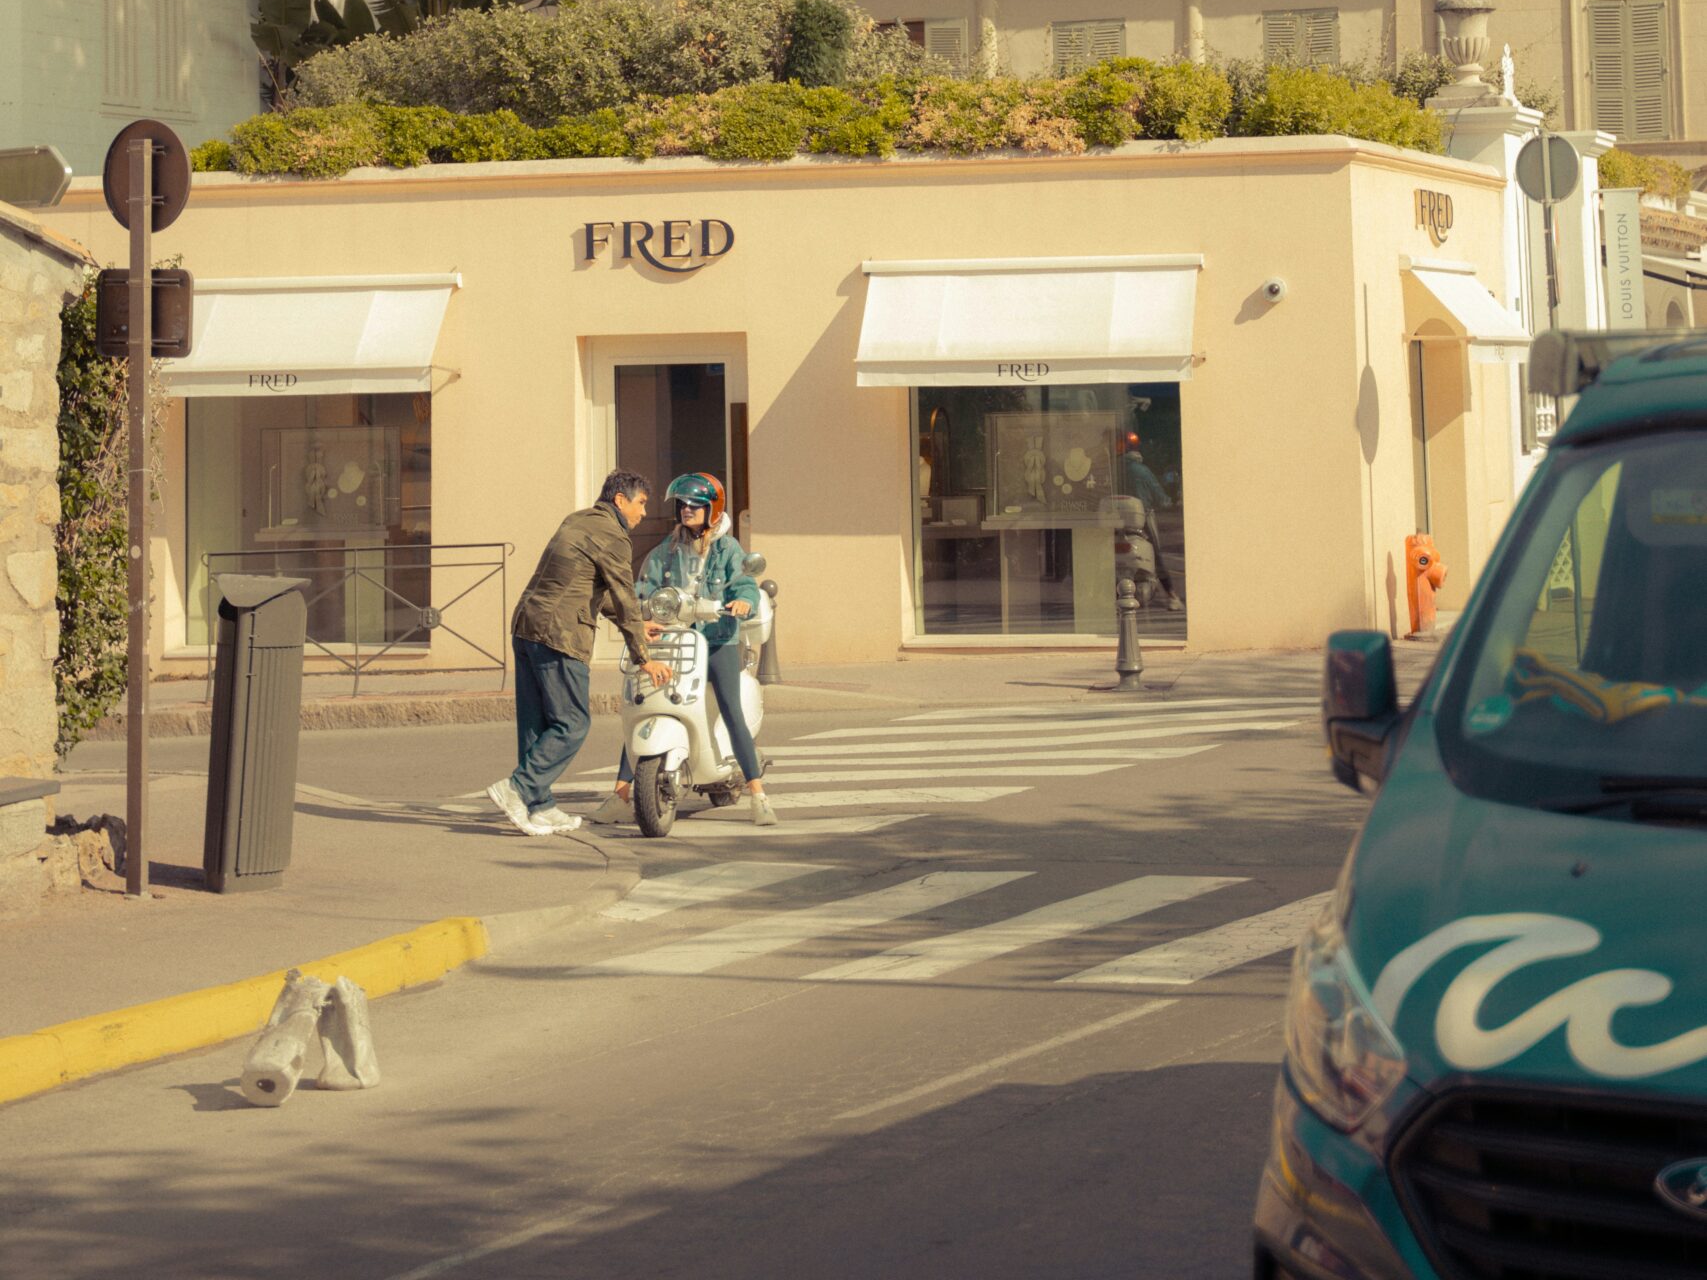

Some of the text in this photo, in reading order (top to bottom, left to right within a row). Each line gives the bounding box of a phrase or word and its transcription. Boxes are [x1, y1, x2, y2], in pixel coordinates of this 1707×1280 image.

[1419, 188, 1454, 243] FRED
[583, 218, 735, 273] FRED
[1616, 213, 1633, 320] LOUIS VUITTON
[248, 374, 298, 392] FRED
[997, 363, 1049, 382] FRED
